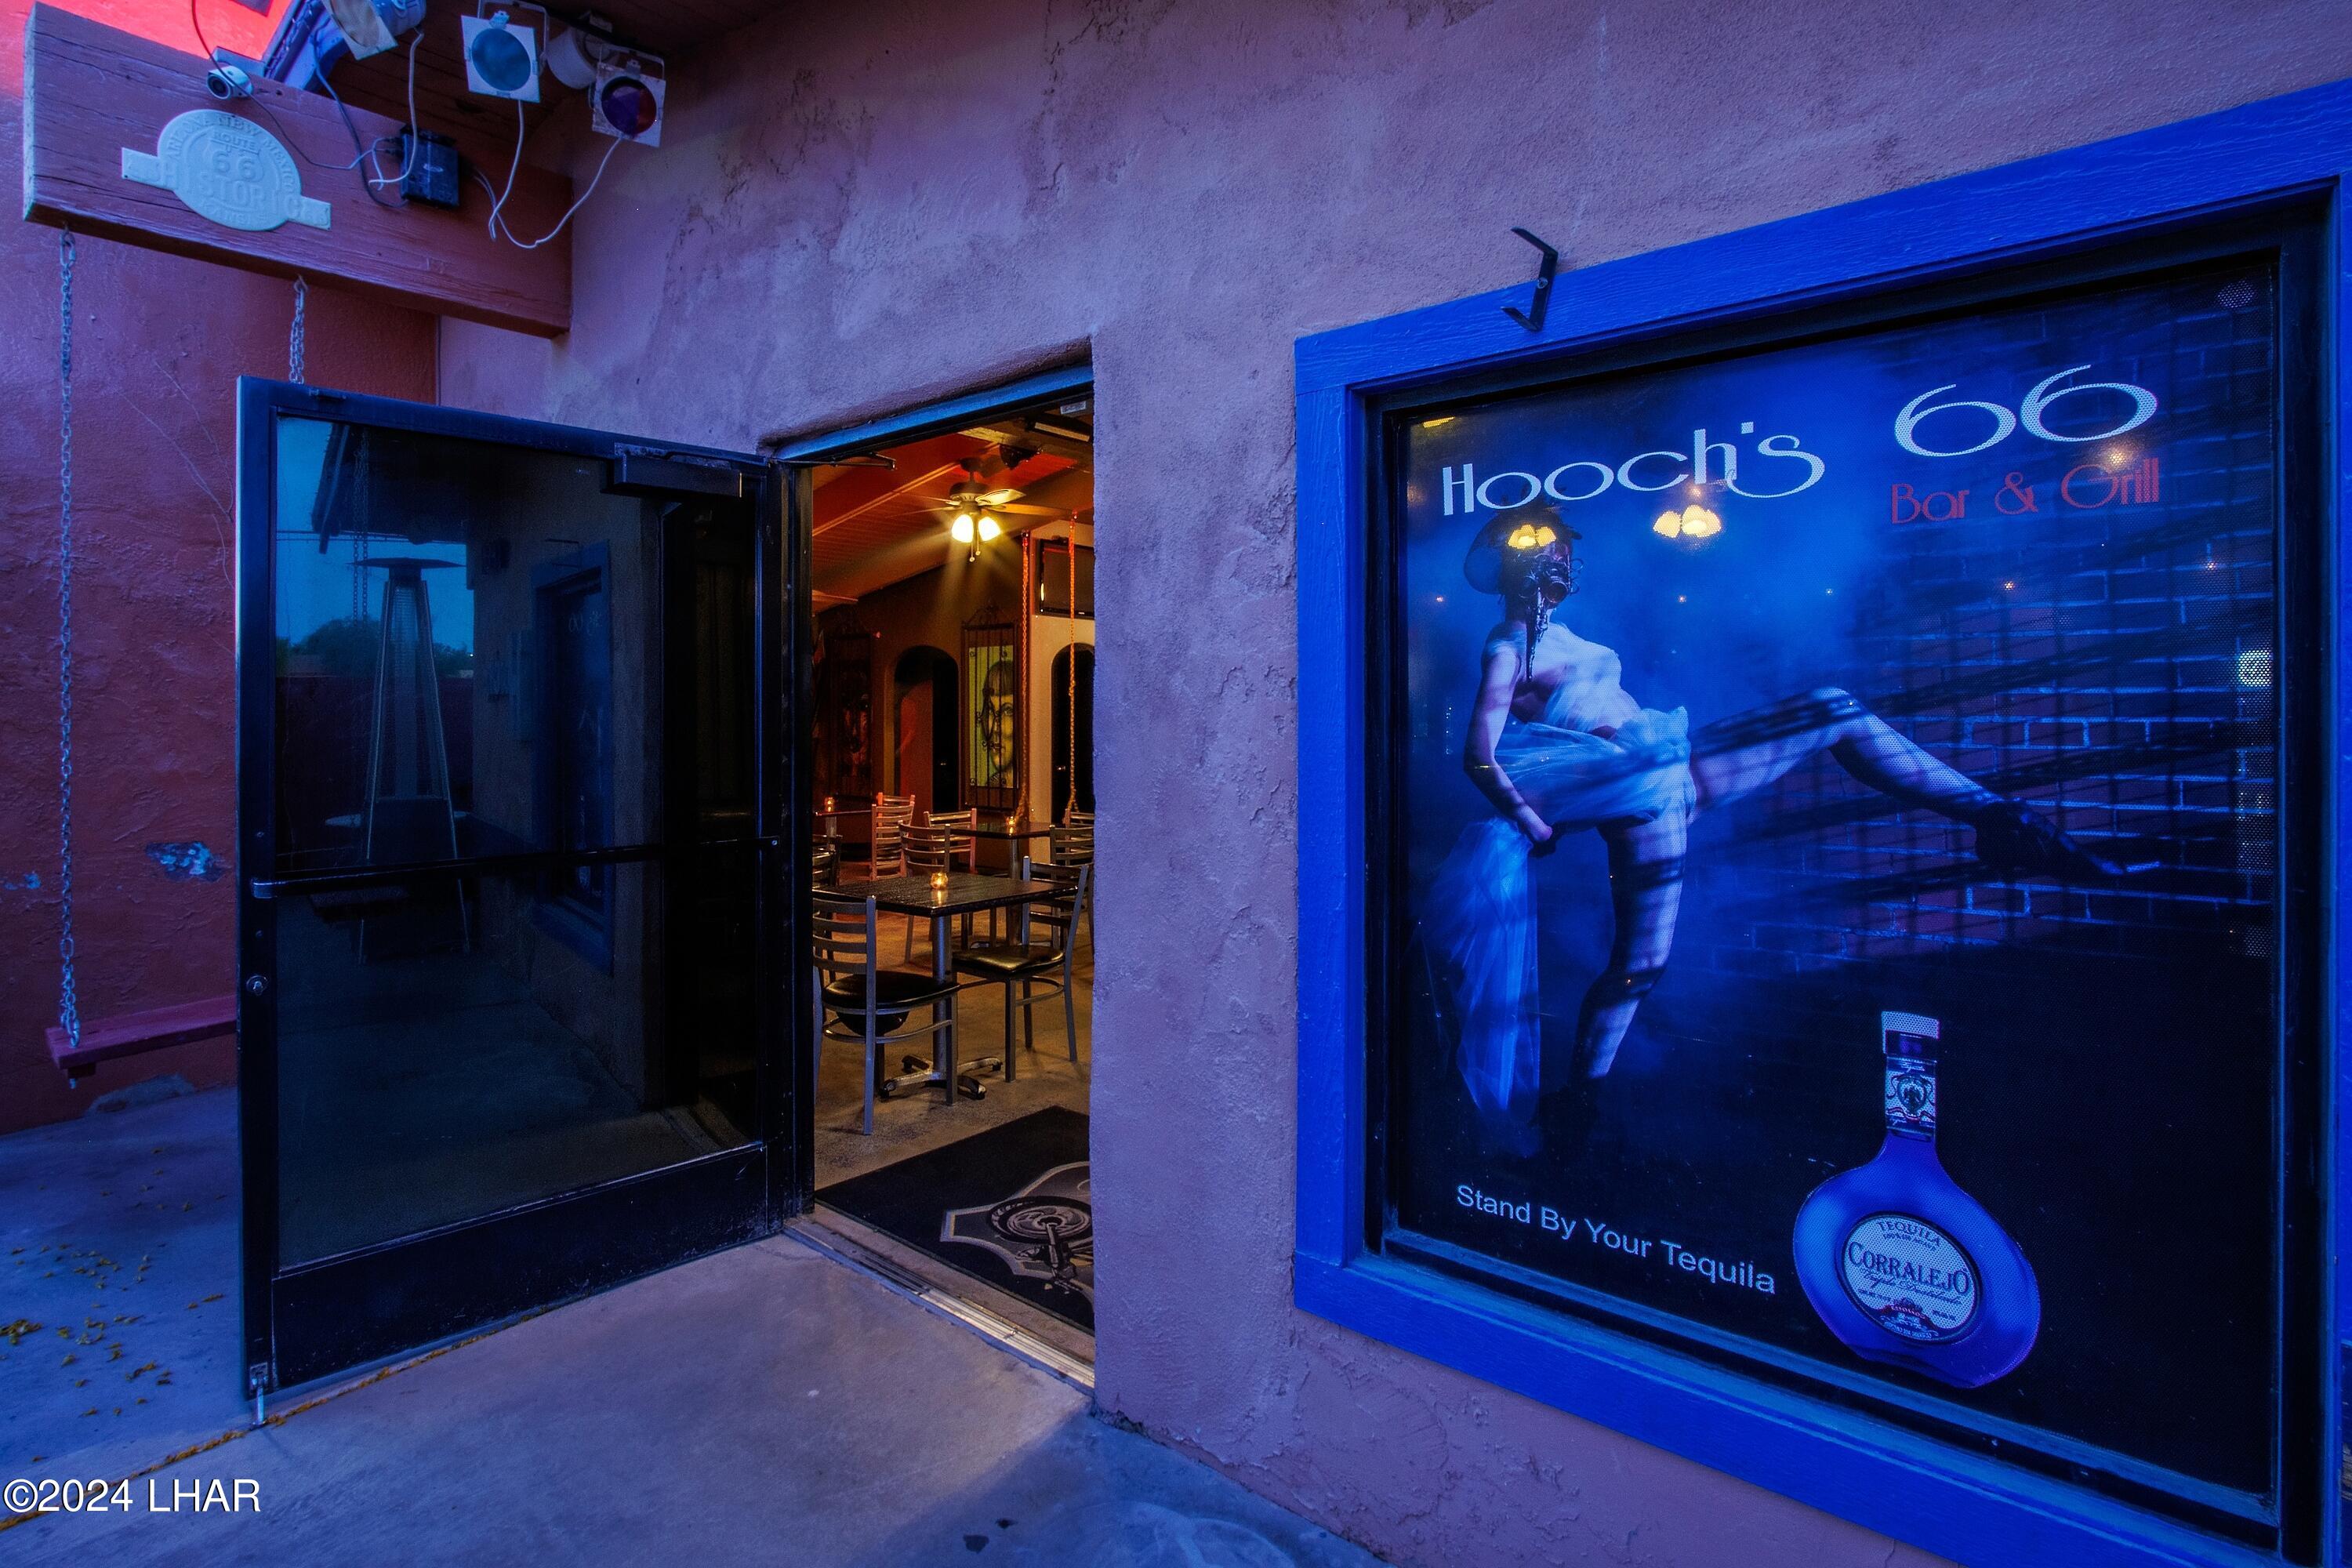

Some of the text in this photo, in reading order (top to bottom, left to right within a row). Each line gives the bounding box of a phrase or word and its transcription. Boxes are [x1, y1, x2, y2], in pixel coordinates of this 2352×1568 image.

[212, 131, 256, 151] ROUTE
[212, 151, 256, 182] 66
[217, 116, 261, 136] NEW
[263, 137, 296, 194] MEXICO
[1894, 364, 2158, 457] 66
[1891, 457, 2161, 524] Bar & Grill
[1456, 1185, 1776, 1294] Stand By Your Tequila
[1876, 1221, 1940, 1247] TEQUILA
[1848, 1241, 1969, 1294] CORRALEJO
